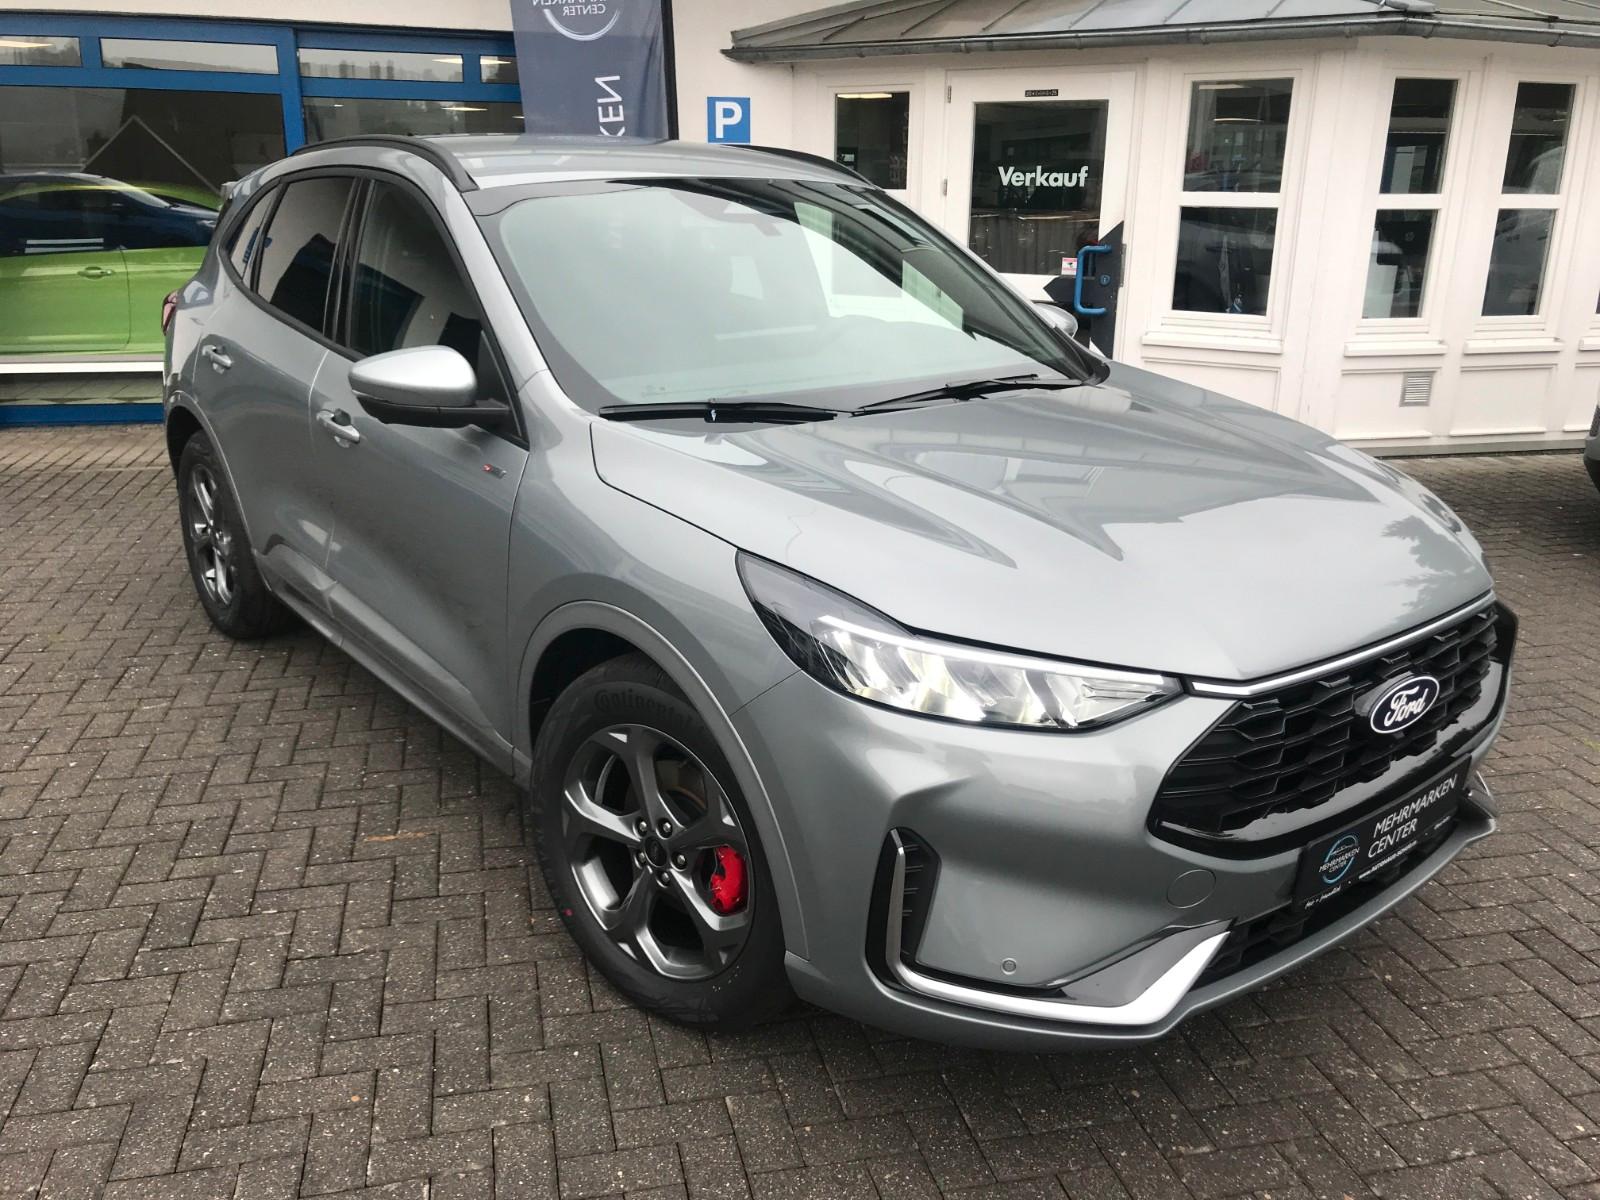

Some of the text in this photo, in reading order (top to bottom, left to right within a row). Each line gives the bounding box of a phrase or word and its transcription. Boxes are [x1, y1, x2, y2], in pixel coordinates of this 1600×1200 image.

[715, 101, 743, 139] P
[997, 165, 1089, 188] Verkauf
[1383, 685, 1429, 727] Ford
[1373, 773, 1458, 839] MEHRMARKEN
[1368, 818, 1418, 858] CENTER
[1319, 847, 1360, 872] MEHRMARKEN
